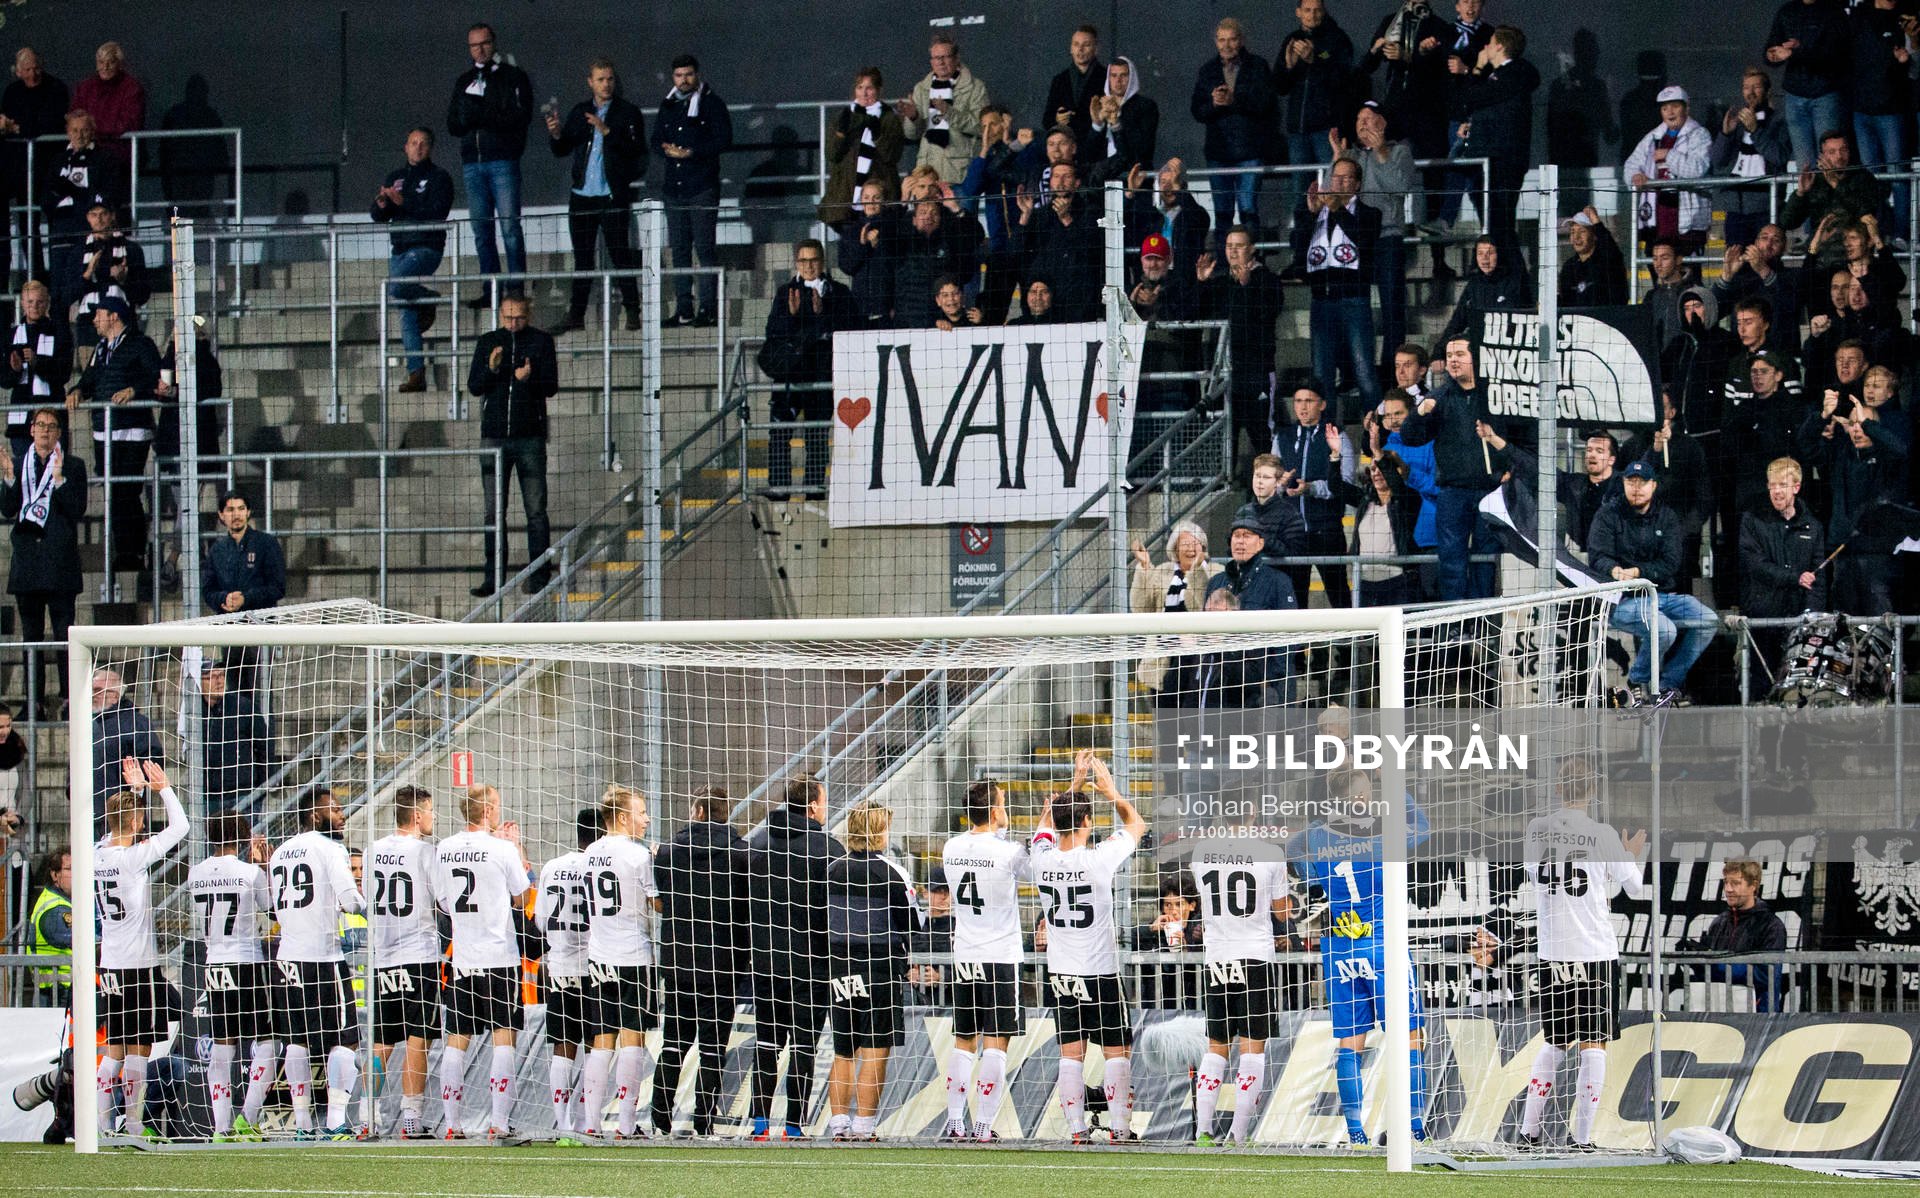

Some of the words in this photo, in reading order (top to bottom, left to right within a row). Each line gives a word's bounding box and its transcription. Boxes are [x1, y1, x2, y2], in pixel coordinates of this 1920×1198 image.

[1483, 313, 1574, 349] ULTRS
[868, 341, 1104, 489] IVAN
[953, 576, 999, 586] FÖRBJUD
[958, 562, 997, 573] RÖKNING
[375, 854, 405, 866] ROGIC
[440, 851, 488, 863] HAGINGE
[1203, 853, 1254, 866] BESARA
[1317, 841, 1373, 861] JANSSON
[190, 877, 244, 889] BOANANIKE
[272, 863, 315, 910] 29
[1333, 861, 1362, 904] 1
[1537, 847, 1589, 898] 46
[373, 870, 414, 917] 20
[452, 867, 478, 913] 2
[583, 871, 622, 917] 19
[956, 871, 985, 916] 4
[1202, 870, 1257, 917] 10
[193, 892, 241, 937] 77
[546, 885, 591, 932] 23
[1038, 884, 1095, 928] 25
[204, 967, 239, 992] NA
[378, 968, 415, 995] NA
[588, 960, 619, 988] NA
[955, 961, 987, 984] NA
[1209, 960, 1247, 987] NA
[1335, 957, 1379, 984] NA
[1552, 961, 1589, 986] NA
[831, 974, 869, 1002] NA
[1050, 975, 1093, 1001] NA
